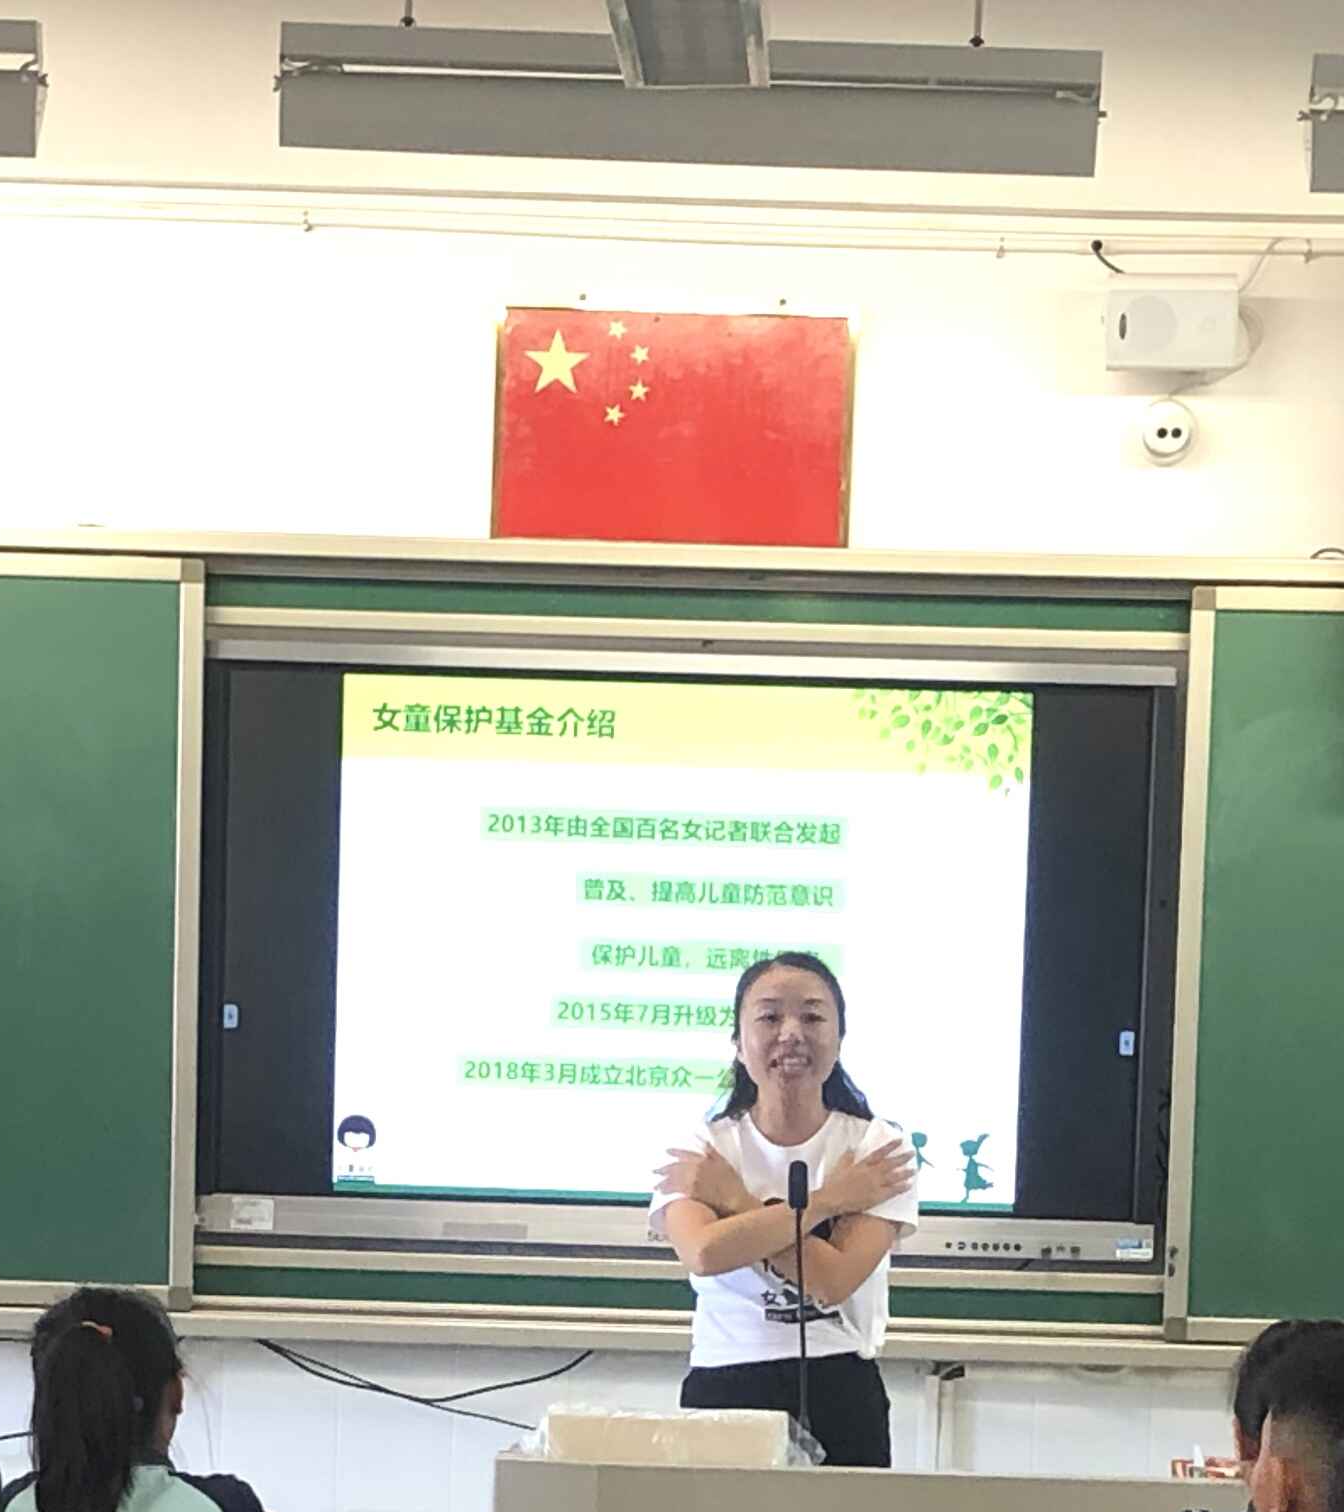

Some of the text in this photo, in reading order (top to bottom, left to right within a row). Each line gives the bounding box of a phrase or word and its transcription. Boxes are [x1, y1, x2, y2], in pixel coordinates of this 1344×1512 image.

[372, 702, 616, 739] 女童保护基金介绍
[487, 813, 841, 845] 2013年由全国百名女记者联合发起
[584, 878, 834, 907] 普及、提高儿童防范意识
